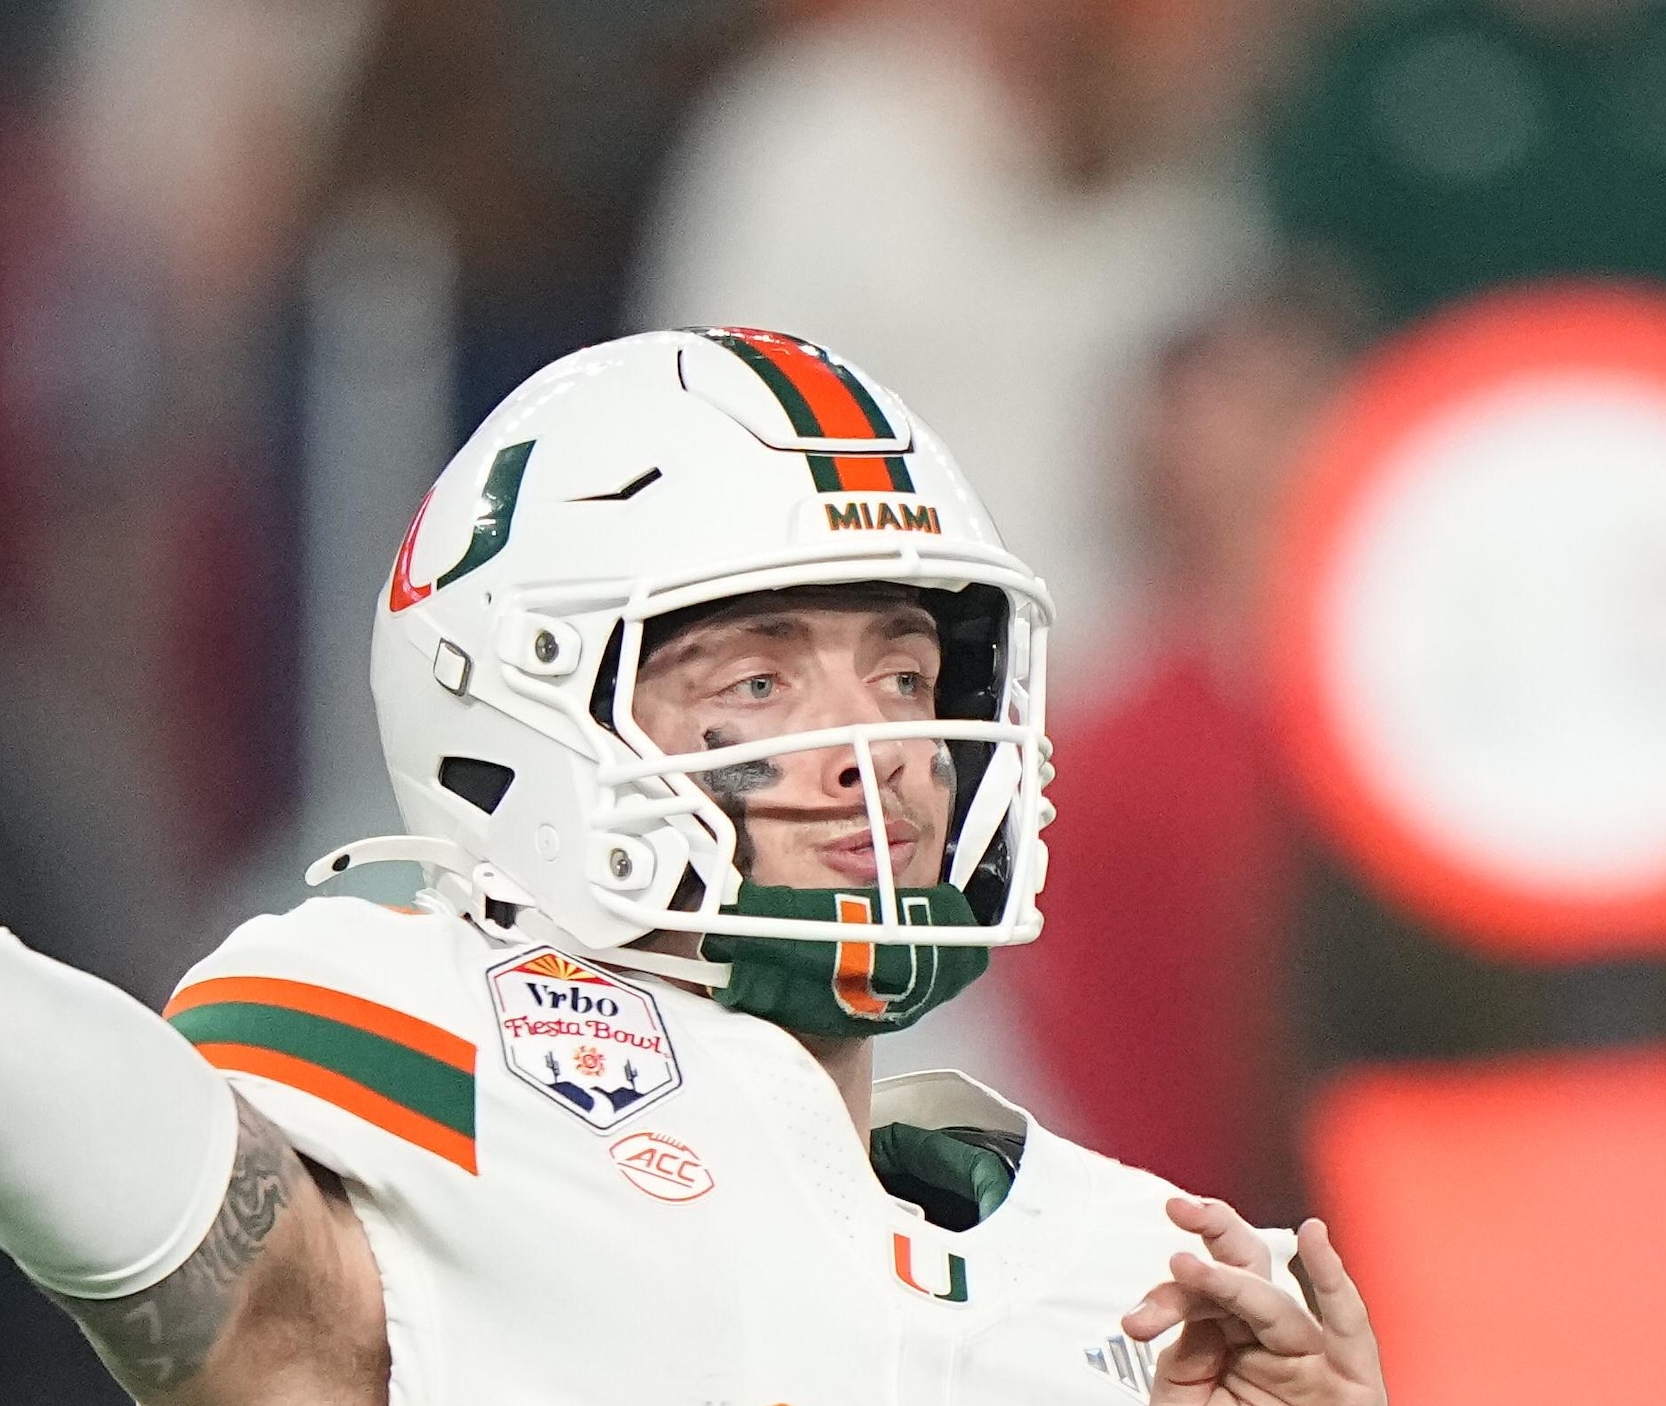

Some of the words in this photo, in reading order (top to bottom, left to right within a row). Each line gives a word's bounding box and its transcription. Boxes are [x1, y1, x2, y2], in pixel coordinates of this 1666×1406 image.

[824, 502, 942, 535] MIAMI
[525, 982, 620, 1017] Vrbo
[504, 1015, 585, 1038] Fiesta
[585, 1020, 664, 1054] Bowl
[627, 1148, 700, 1182] ACC
